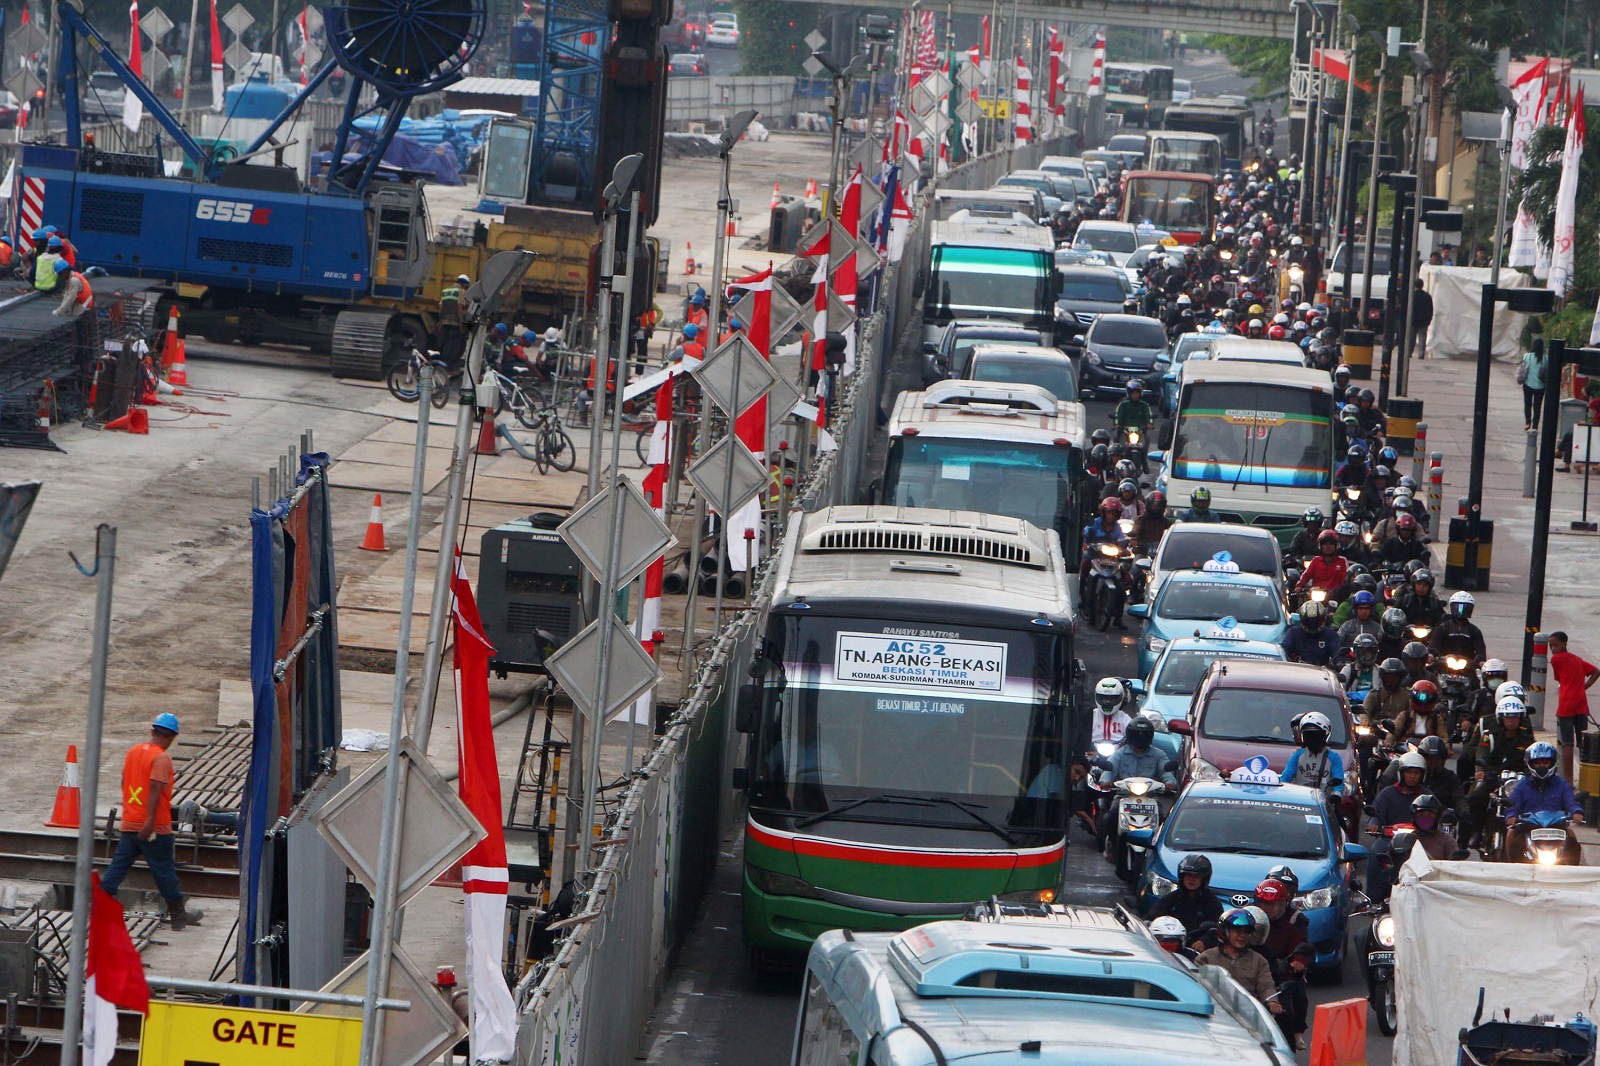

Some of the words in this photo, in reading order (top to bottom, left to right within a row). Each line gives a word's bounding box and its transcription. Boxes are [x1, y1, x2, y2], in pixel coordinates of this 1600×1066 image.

[1244, 425, 1268, 440] 19
[532, 534, 560, 542] AIRMAN
[1209, 564, 1234, 572] TAKSI
[882, 626, 918, 637] RAHAYU
[919, 629, 960, 640] SANTOSA
[1212, 631, 1240, 639] TAKSI
[886, 641, 914, 654] AC
[919, 643, 946, 656] 52
[843, 649, 1000, 673] TN.ABANG-BEKASI
[882, 666, 926, 676] BEKASI
[929, 668, 968, 679] TIMUR
[877, 699, 900, 710] BEKASI
[901, 700, 921, 712] TIMUR
[1504, 702, 1520, 711] PM
[1238, 773, 1272, 783] TAKSI
[1272, 803, 1312, 812] GROUP
[212, 1017, 297, 1048] GATE
